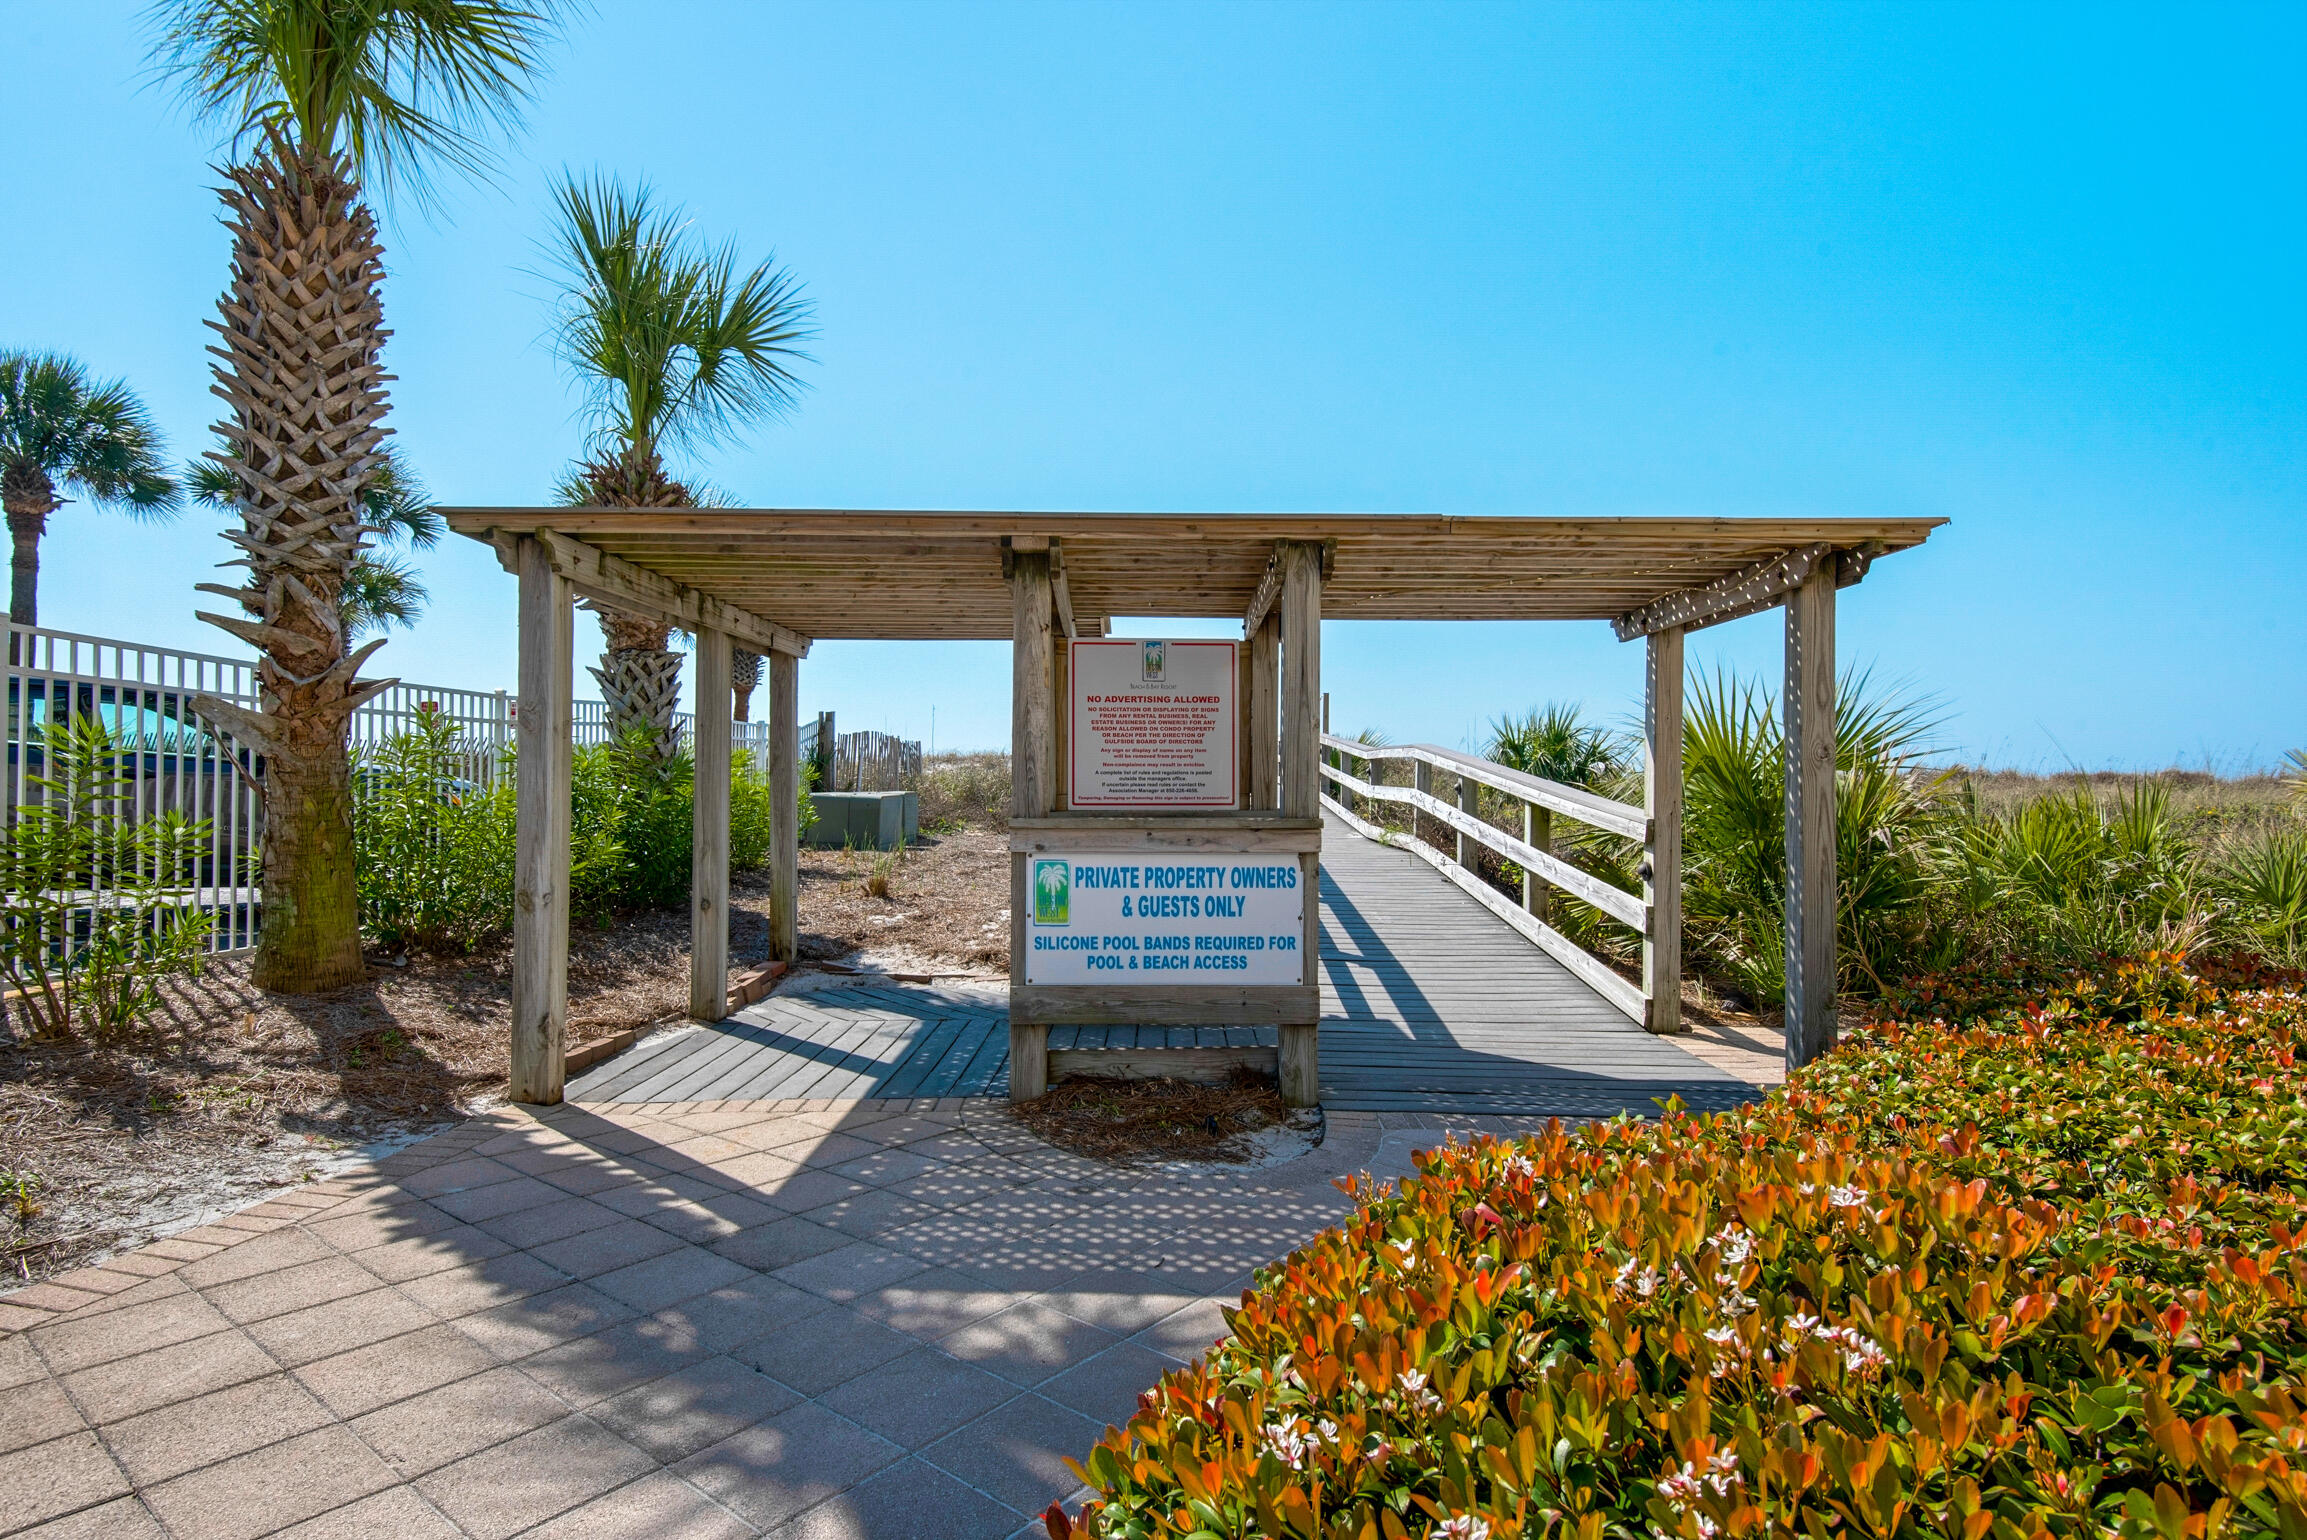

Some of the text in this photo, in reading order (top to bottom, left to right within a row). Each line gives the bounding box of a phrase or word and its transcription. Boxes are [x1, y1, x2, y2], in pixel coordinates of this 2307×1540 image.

[1075, 867, 1297, 889] PRIVATE PROPERTY OWNERS
[1039, 907, 1059, 917] WEST
[1121, 896, 1246, 918] & GUESTS ONLY
[1034, 936, 1296, 950] SILICONE POOL BANDS REQUIRED FOR
[1087, 955, 1247, 970] POOL & BEACH ACCESS
